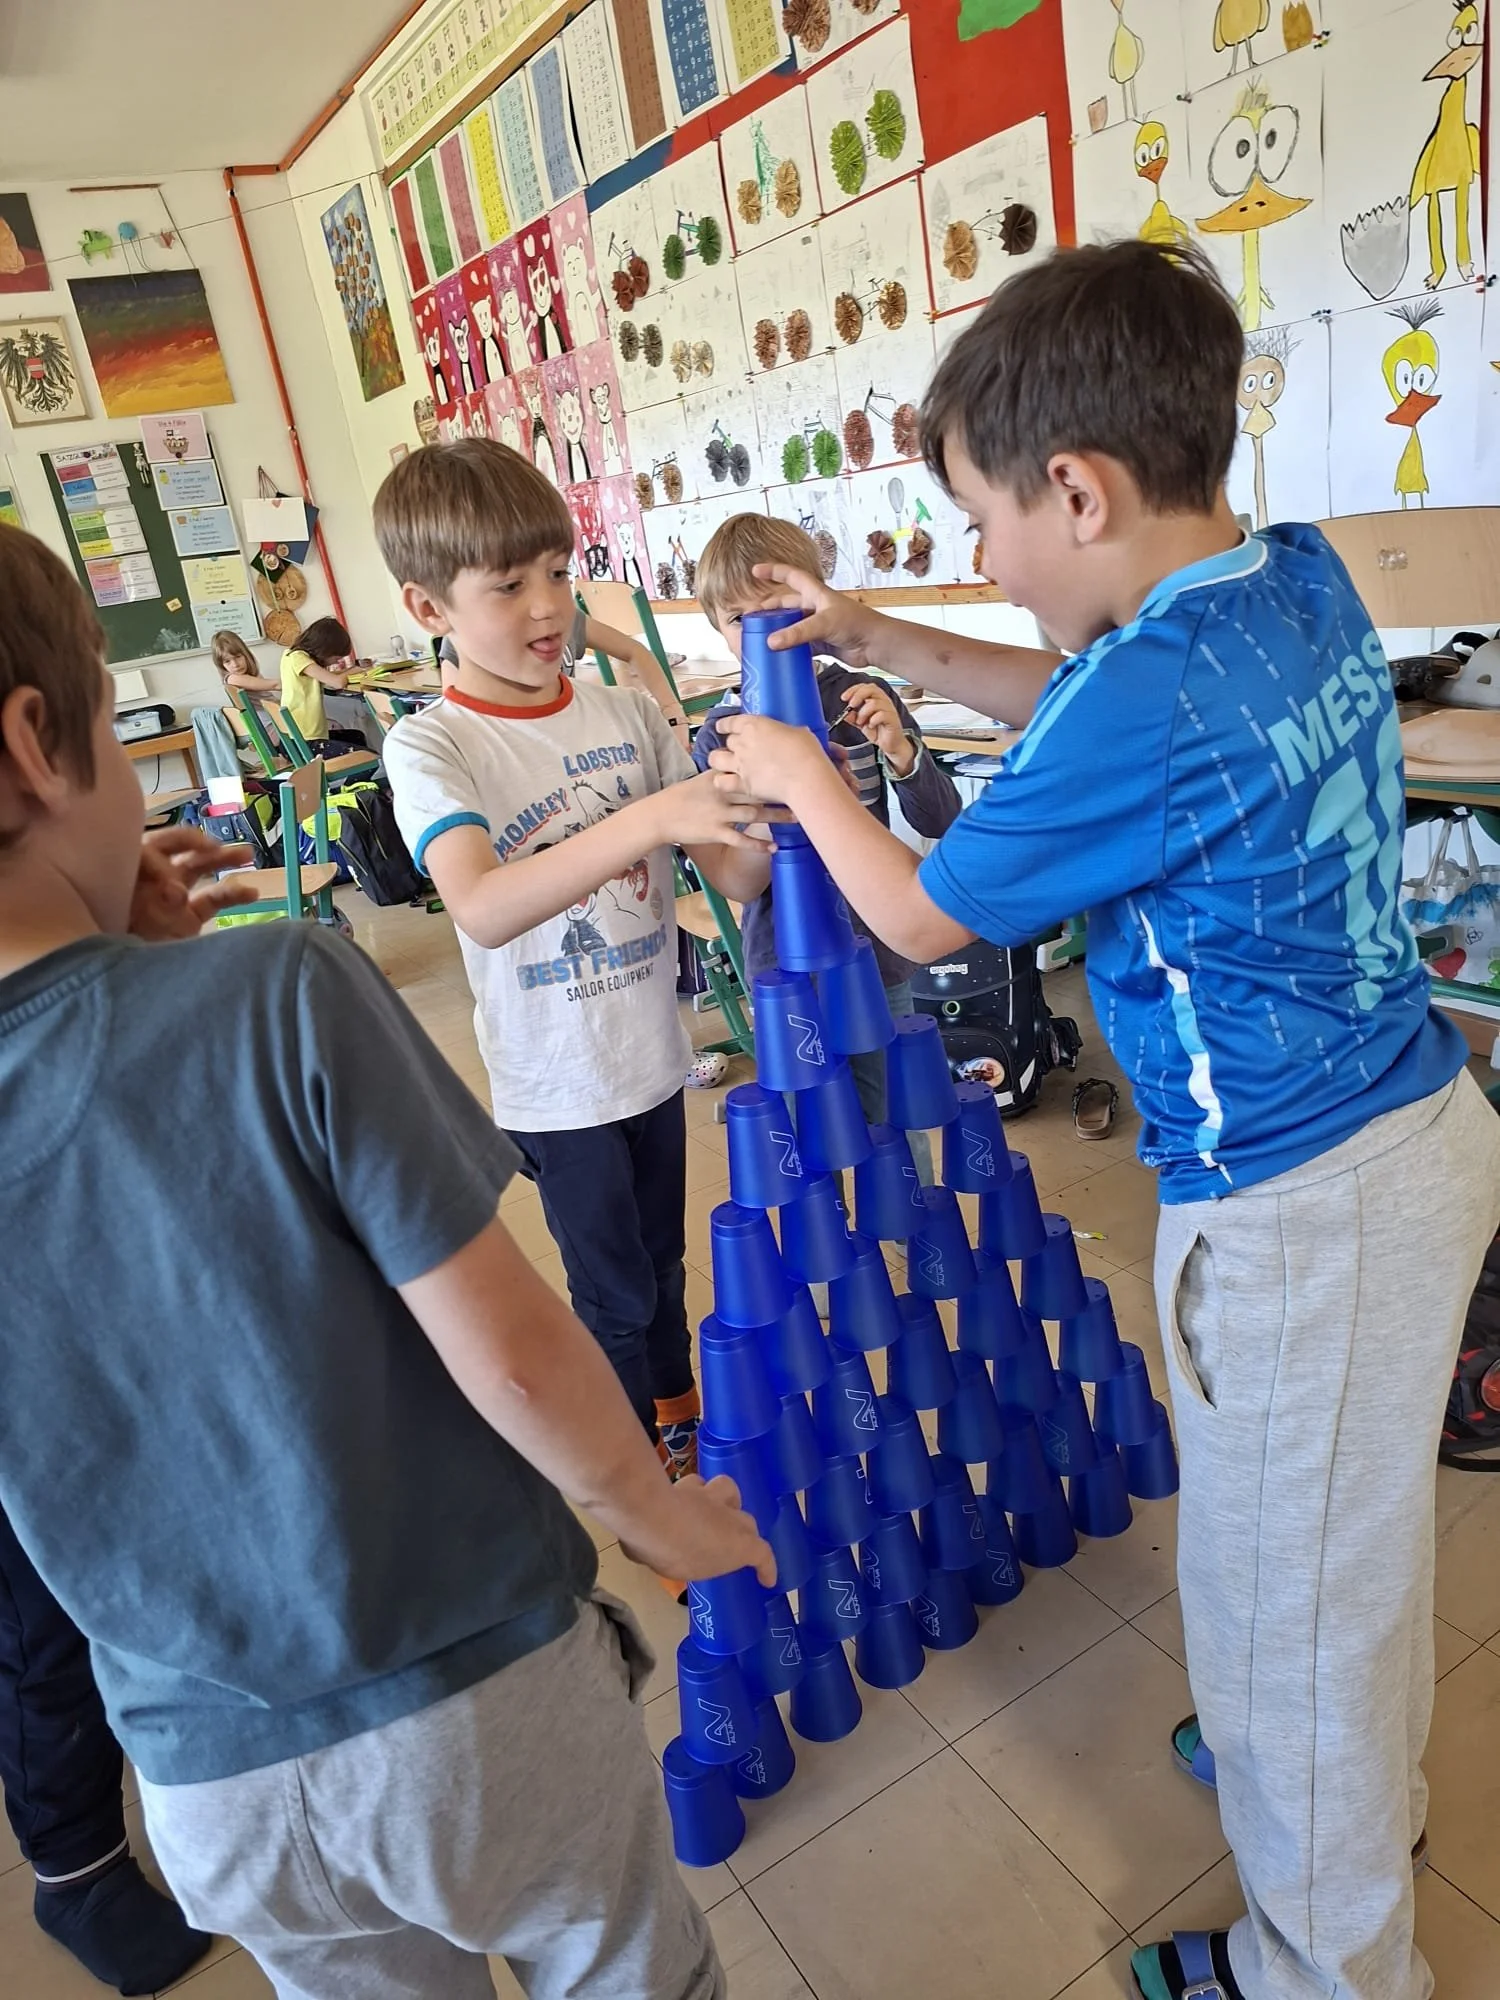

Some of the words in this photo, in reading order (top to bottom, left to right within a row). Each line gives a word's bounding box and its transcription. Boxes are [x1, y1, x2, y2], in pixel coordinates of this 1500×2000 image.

[562, 742, 640, 778] LOBSTER
[616, 775, 631, 798] &
[493, 787, 571, 863] MONKEY
[516, 953, 584, 991] BEST
[566, 979, 606, 1002] SAILOR
[608, 962, 654, 992] EQUIPMENT
[929, 963, 969, 977] ergobag
